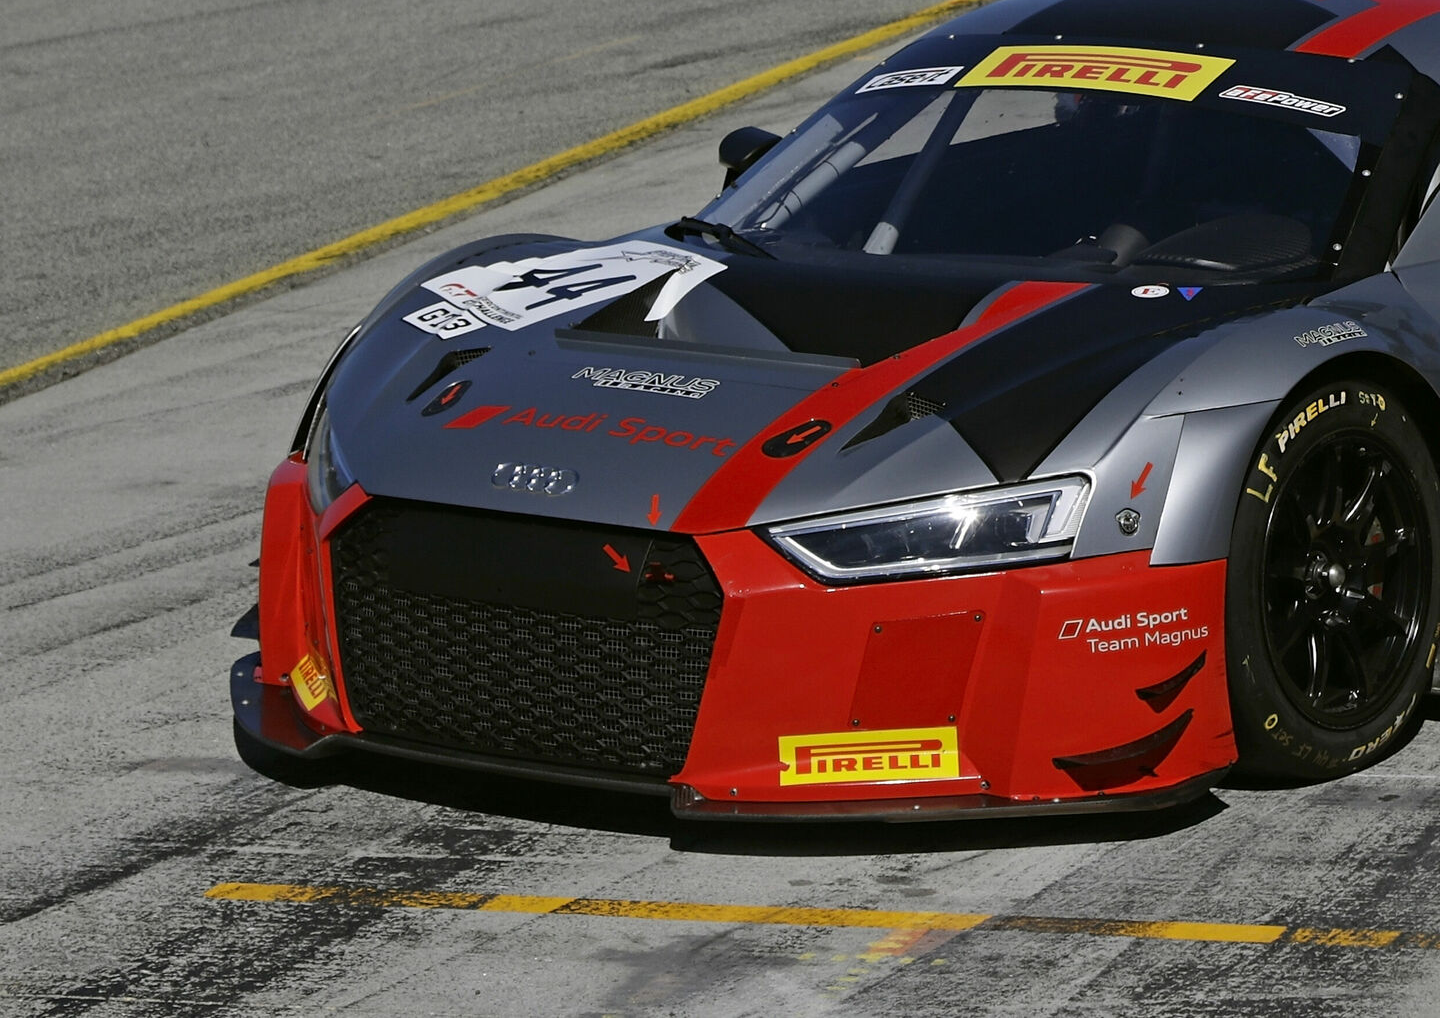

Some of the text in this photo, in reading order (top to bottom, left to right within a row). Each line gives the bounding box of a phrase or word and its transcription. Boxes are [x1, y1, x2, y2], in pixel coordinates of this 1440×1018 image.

[985, 53, 1204, 89] PIRELLI
[1224, 86, 1341, 114] aFePower
[493, 263, 637, 311] 44
[1293, 320, 1362, 348] MAGNUS
[571, 366, 720, 392] MAGNUS
[502, 407, 737, 457] Audi Sport
[1277, 391, 1346, 454] PIRELLI
[1246, 452, 1278, 503] LF
[1086, 607, 1188, 633] Audi Sport
[1087, 626, 1209, 653] Team Magnus
[795, 739, 943, 775] PIRELLI
